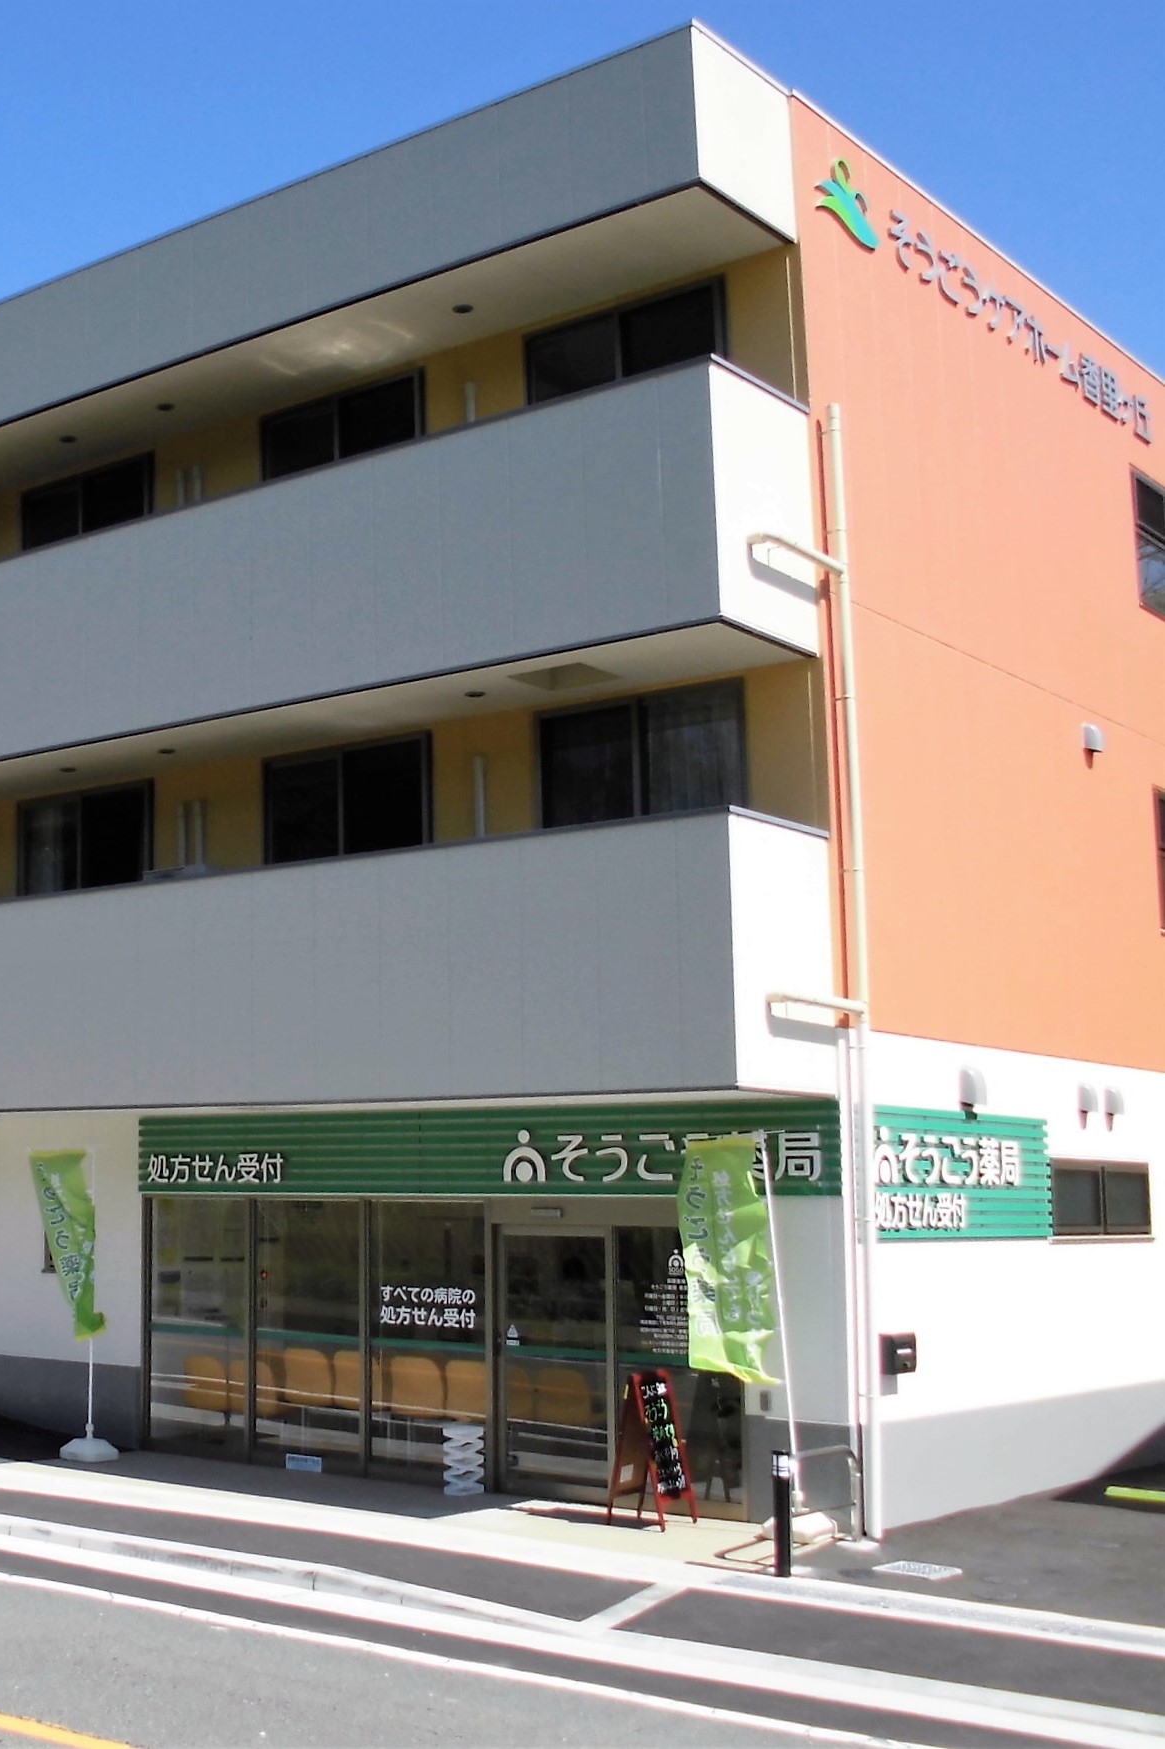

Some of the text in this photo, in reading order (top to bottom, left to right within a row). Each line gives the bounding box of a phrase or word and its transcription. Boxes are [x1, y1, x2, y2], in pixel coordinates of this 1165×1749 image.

[148, 1153, 284, 1183] 処方せん受付
[551, 1132, 821, 1182] そうご局
[897, 1133, 1020, 1187] そうごう薬局
[874, 1192, 967, 1231] 処方せん受付
[380, 1286, 475, 1304] すべての病院の
[380, 1305, 476, 1329] 処方せん受付
